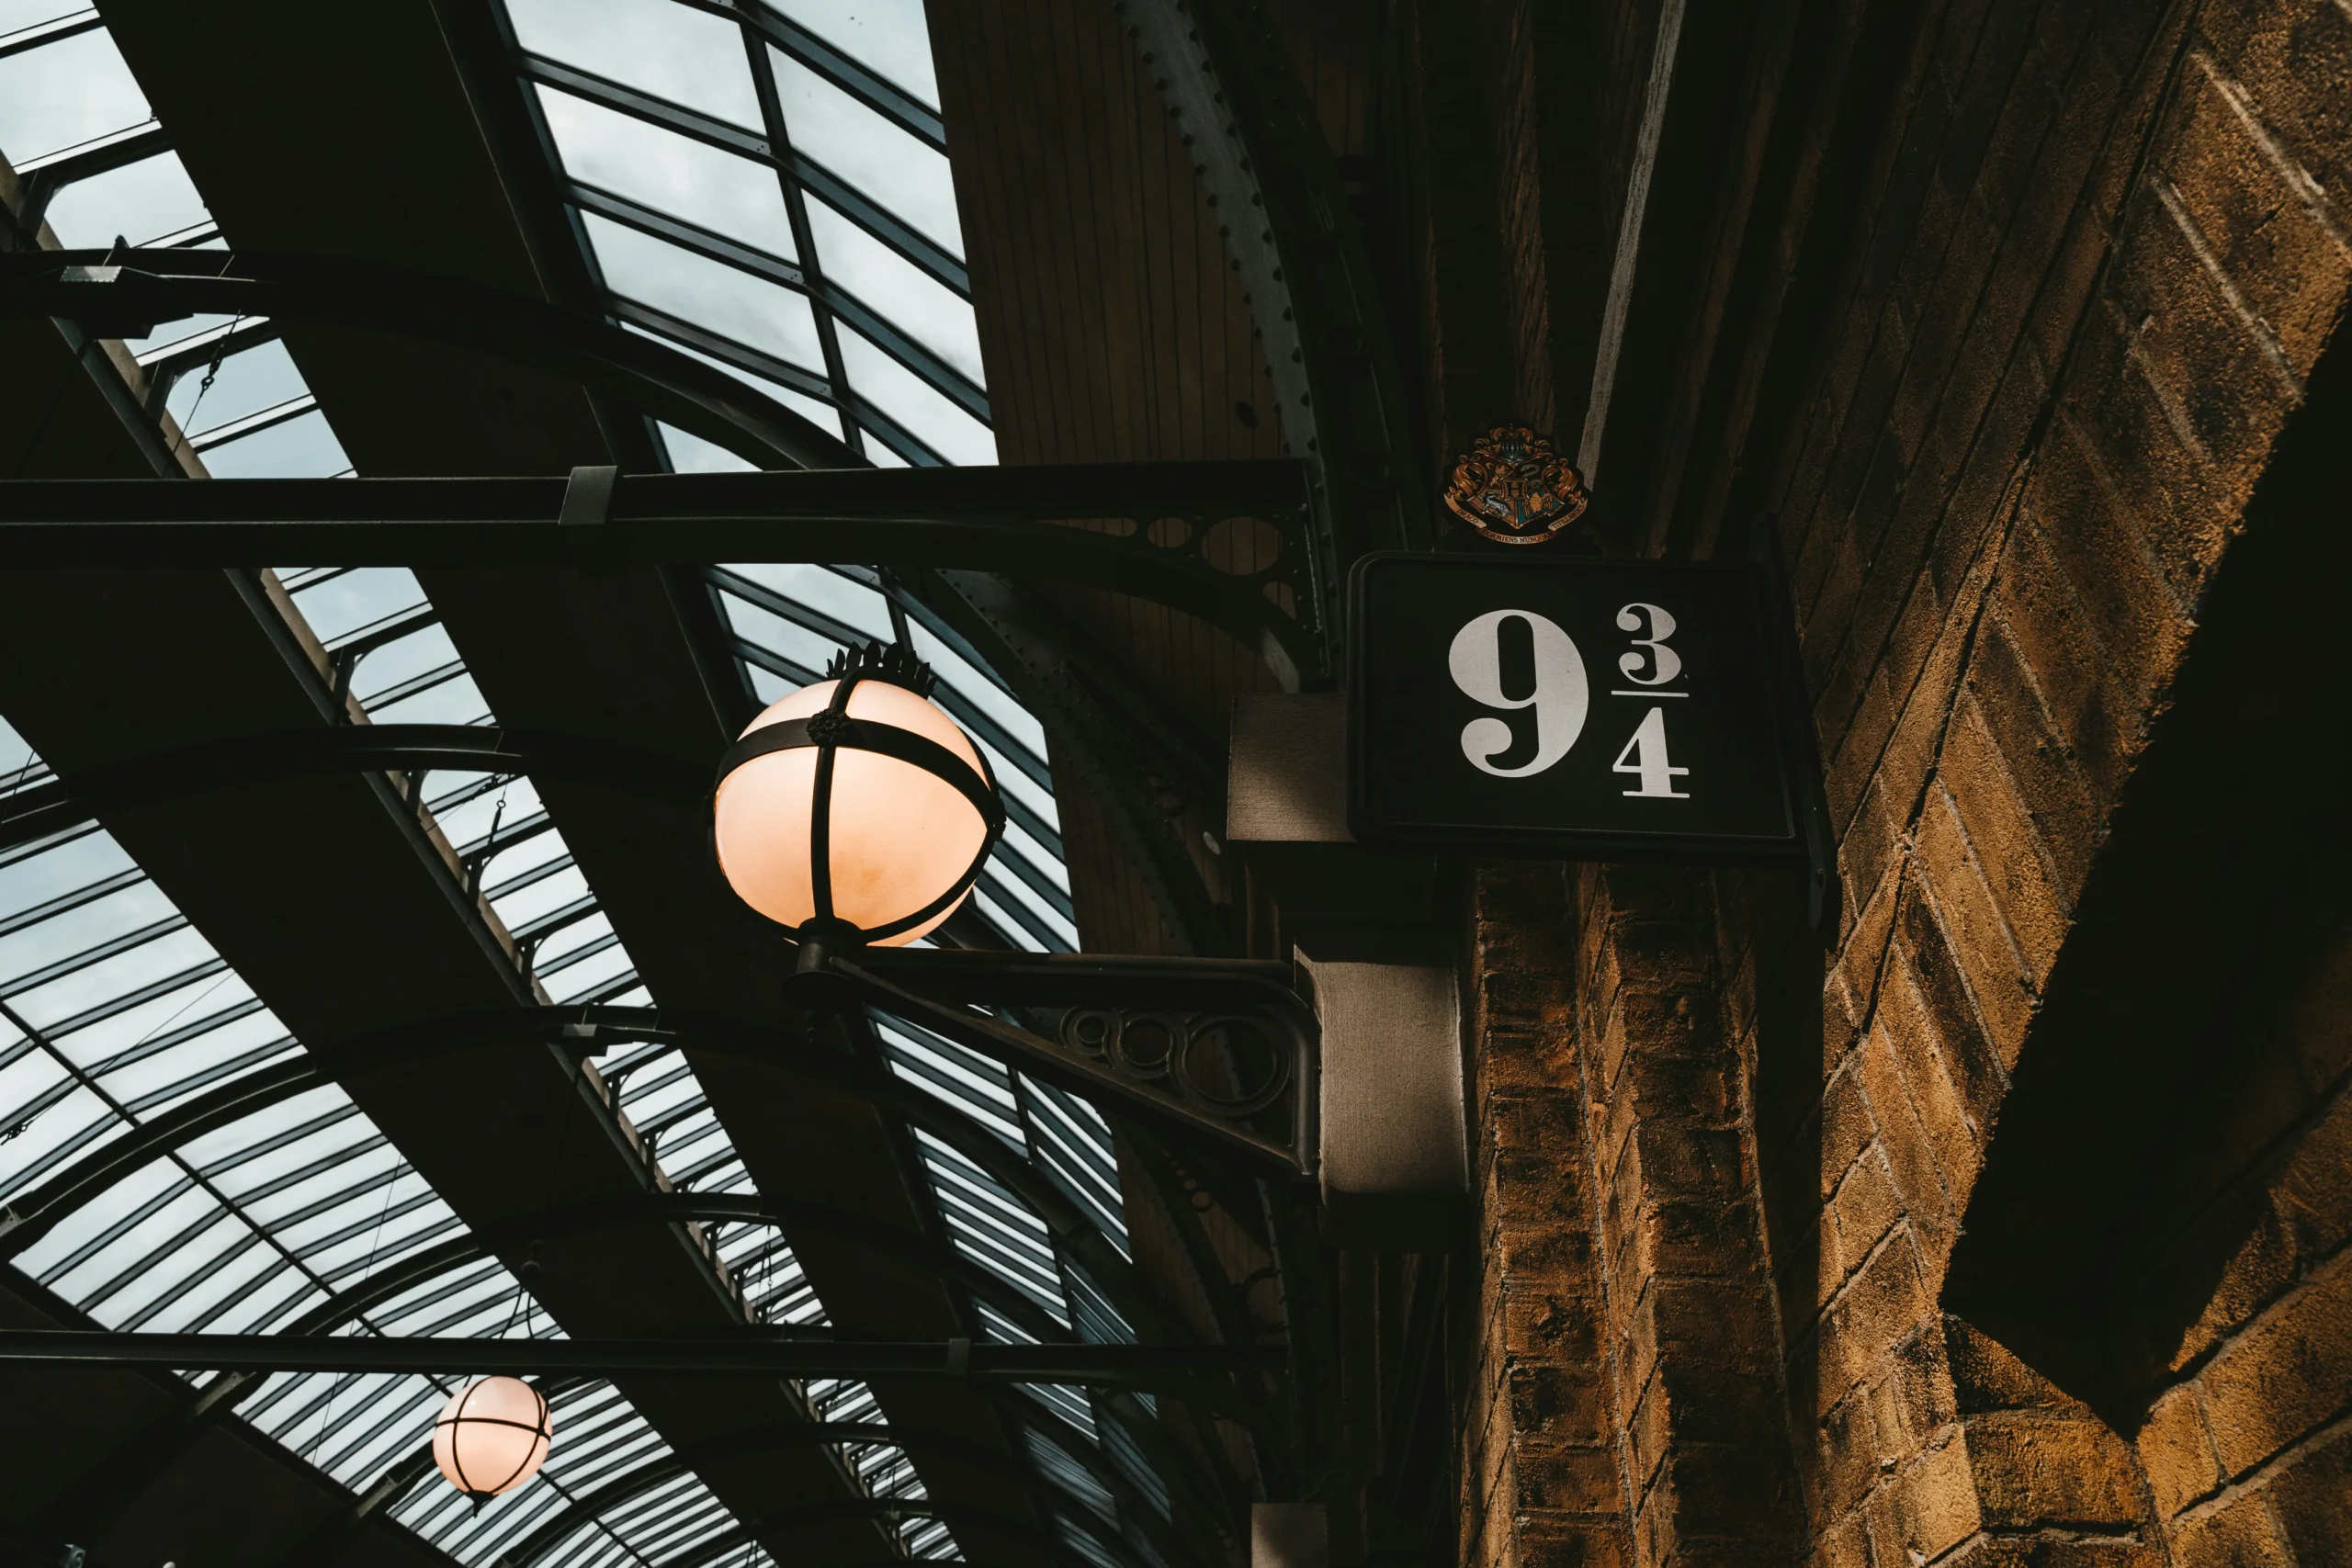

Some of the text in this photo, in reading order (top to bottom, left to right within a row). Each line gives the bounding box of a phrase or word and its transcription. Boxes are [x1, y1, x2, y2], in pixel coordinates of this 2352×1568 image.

[1507, 480, 1523, 498] H
[1456, 508, 1479, 525] DRACO
[1482, 528, 1519, 544] DORMIENS
[1449, 610, 1589, 778] 9
